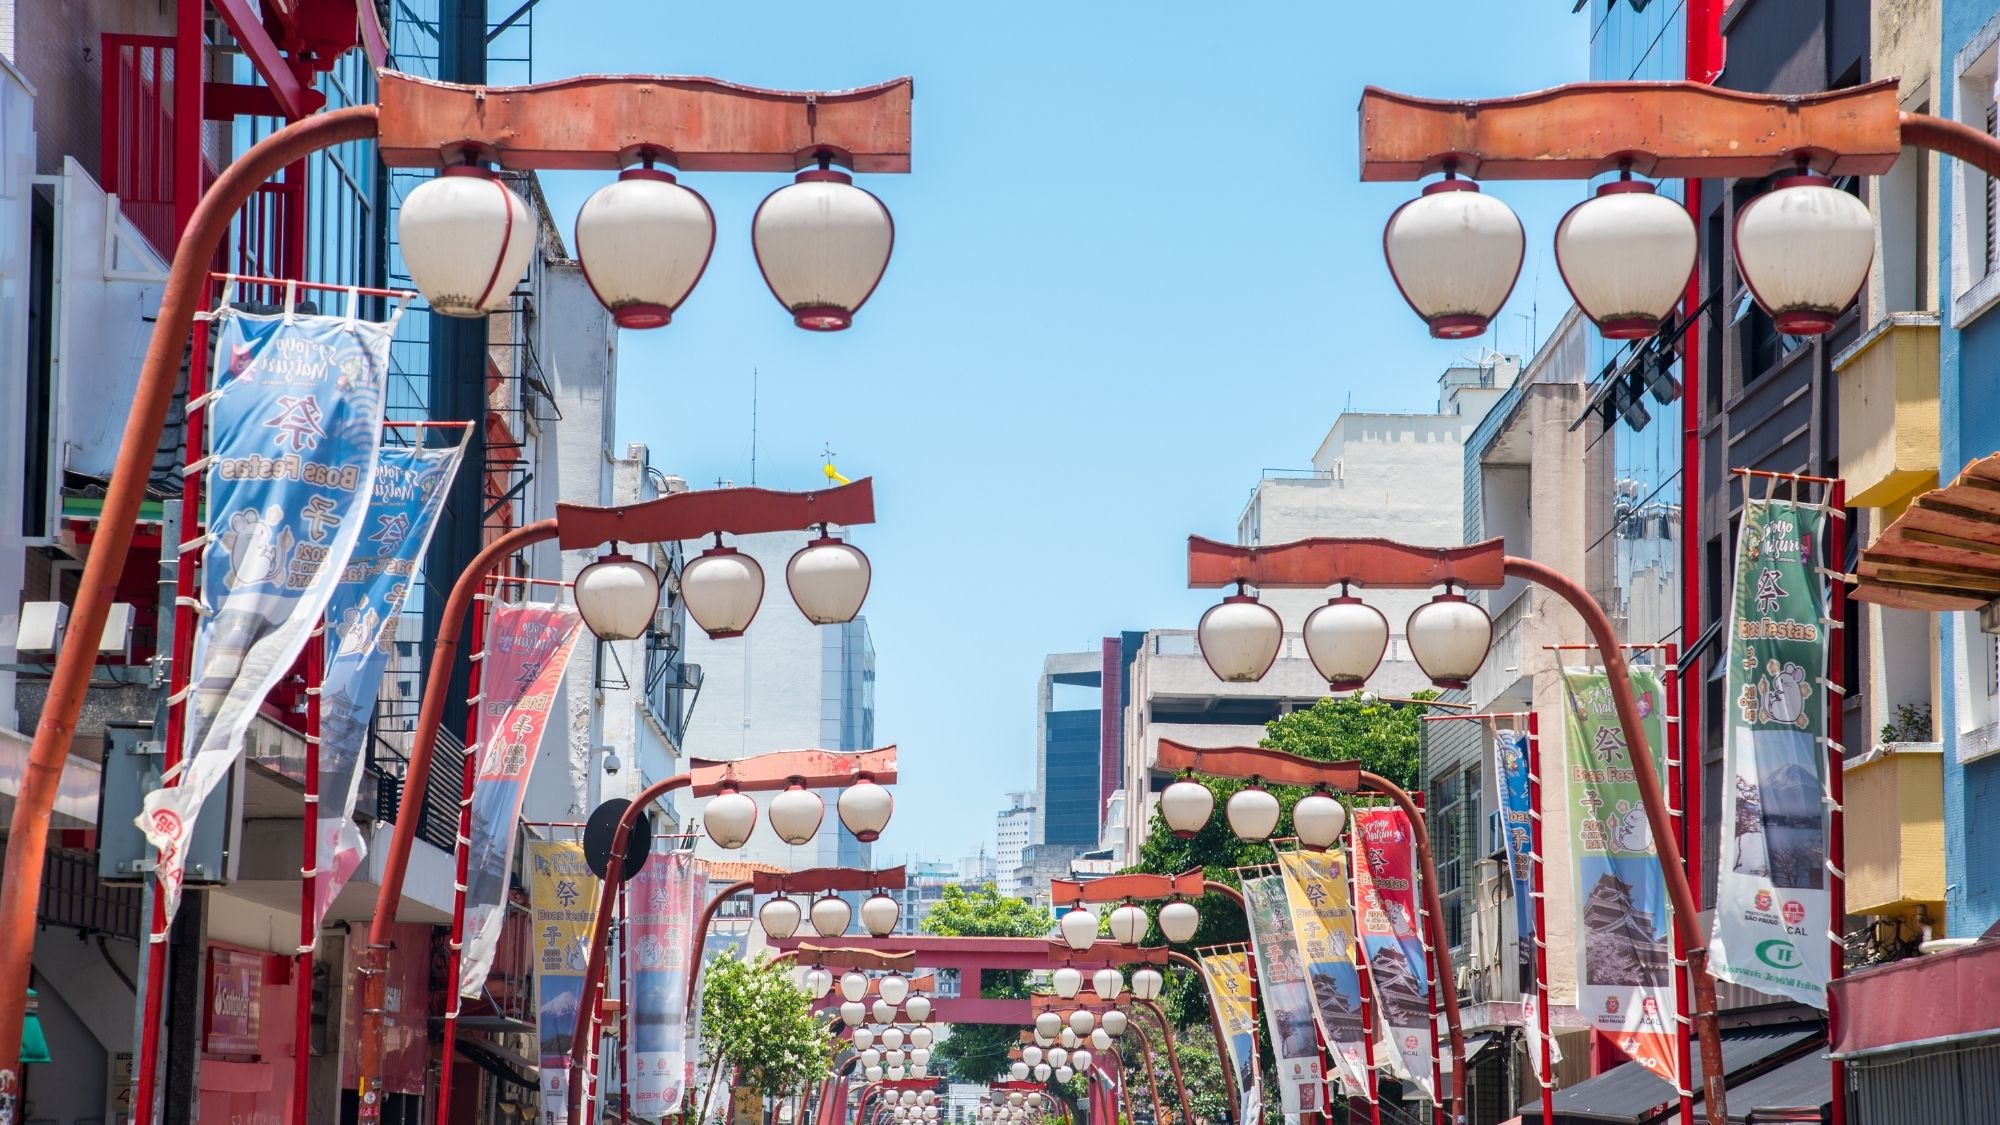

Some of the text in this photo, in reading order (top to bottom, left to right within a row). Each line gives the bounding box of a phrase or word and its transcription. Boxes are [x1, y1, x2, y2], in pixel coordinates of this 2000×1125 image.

[1754, 566, 1789, 616] 祭
[1760, 617, 1818, 642] Festas
[1602, 686, 1612, 701] To
[1593, 725, 1627, 763] 祭
[1580, 789, 1604, 818] 子
[1369, 848, 1389, 875] 祭
[556, 880, 580, 907] 祭
[1306, 883, 1328, 907] 祭
[537, 908, 564, 921] Boas
[1758, 917, 1779, 926] PAULO
[541, 926, 562, 947] 子
[1303, 920, 1321, 939] 子
